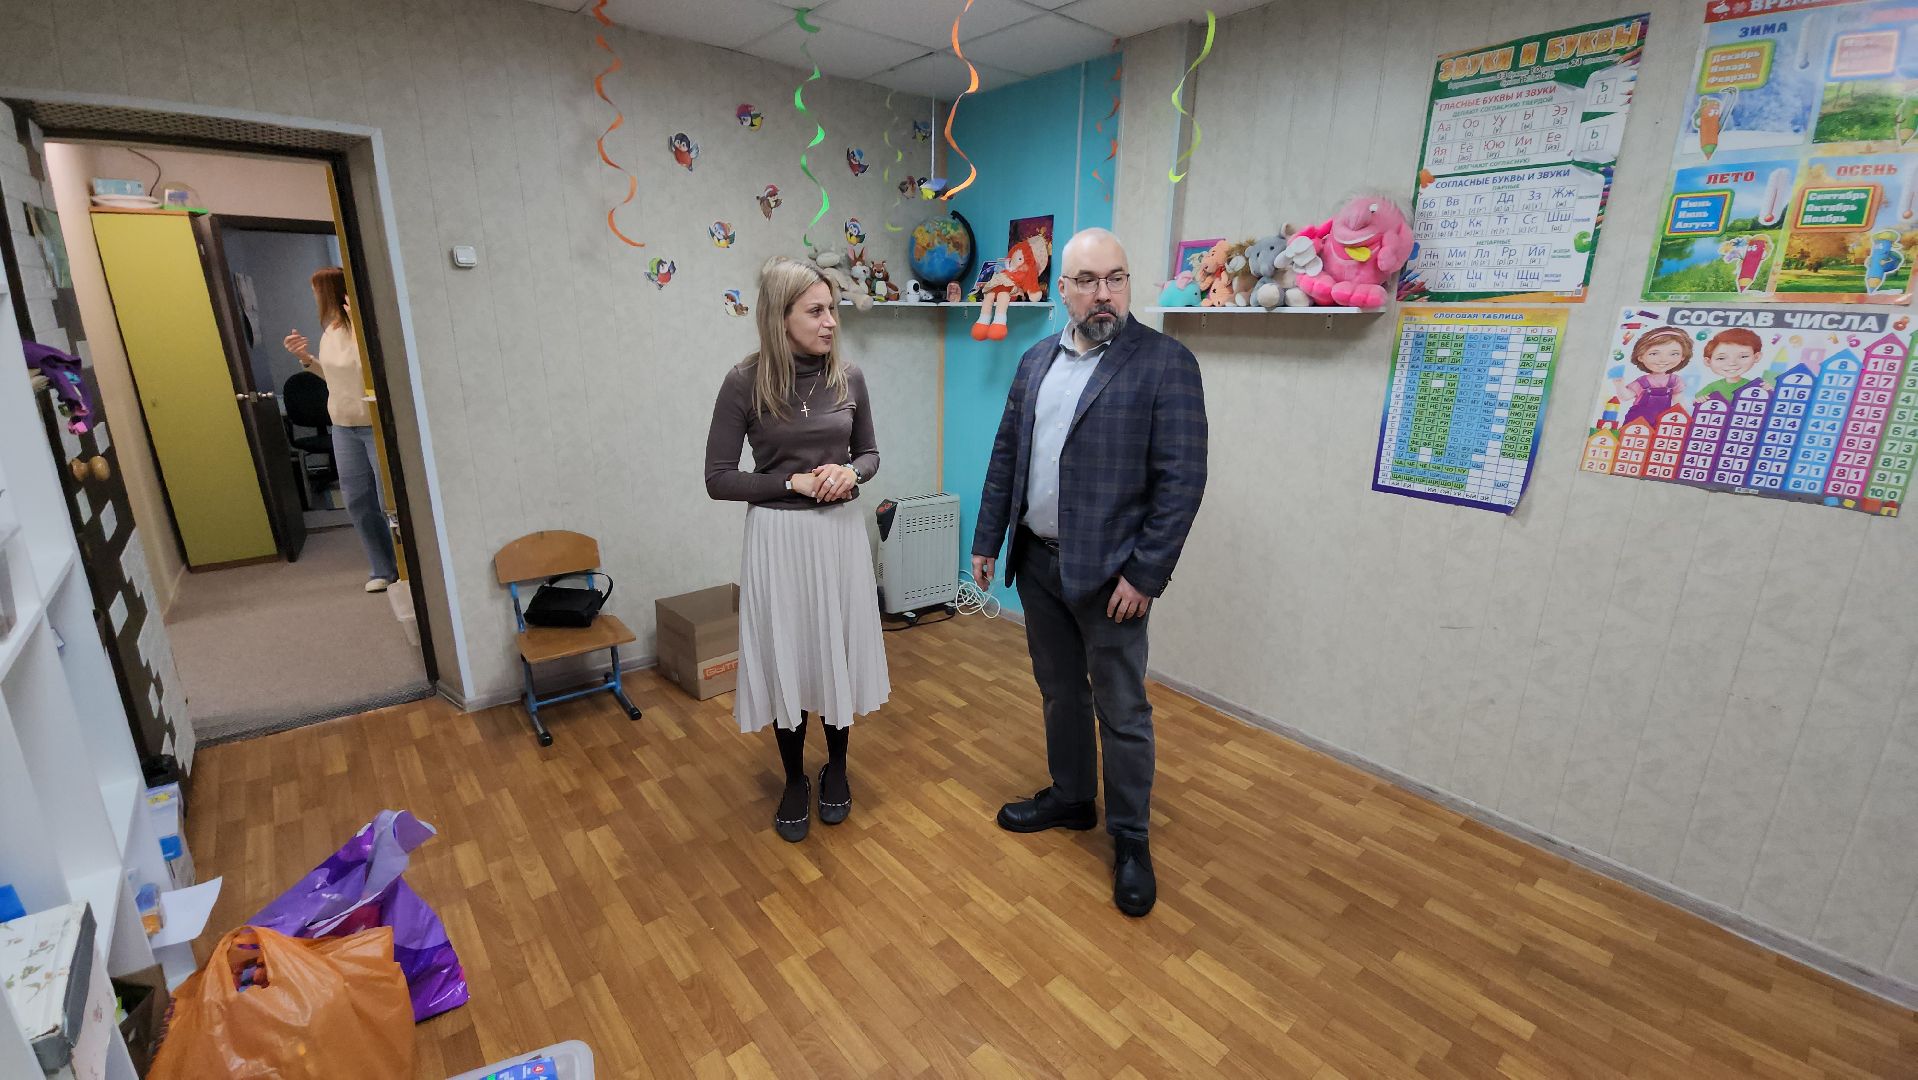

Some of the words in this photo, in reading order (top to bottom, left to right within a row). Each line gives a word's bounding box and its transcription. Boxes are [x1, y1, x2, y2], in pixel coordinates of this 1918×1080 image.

[1738, 22, 1788, 38] ЗИМА
[1438, 47, 1514, 82] ЗВУКИ
[1519, 42, 1539, 67] И
[1544, 24, 1641, 61] БУКВЫ
[1439, 99, 1481, 111] ГЛАСНЫЕ
[1482, 94, 1513, 105] БУКВЫ
[1525, 86, 1557, 98] ЗВУКИ
[1437, 123, 1451, 132] Аа
[1462, 119, 1479, 129] Оо
[1492, 114, 1507, 126] Уу
[1523, 109, 1534, 120] Ы
[1552, 105, 1568, 116] Ээ
[1483, 139, 1505, 150] Юю
[1836, 164, 1898, 177] ОСЕНЬ
[1435, 179, 1490, 189] СОГЛАСНЫЕ
[1492, 175, 1524, 185] БУКВЫ
[1537, 169, 1571, 179] ЗВУКИ
[1706, 171, 1755, 185] ЛЕТО
[1497, 193, 1514, 204] Дд
[1527, 191, 1541, 201] Зз
[1552, 187, 1576, 198] Жж
[1547, 211, 1571, 222] Шш
[1447, 249, 1466, 258] Мм
[1501, 247, 1517, 259] Рр
[1673, 310, 1774, 327] СОСТАВ
[1784, 312, 1880, 331] ЧИСЛА
[1883, 345, 1894, 354] 9
[1838, 361, 1847, 370] 8
[1872, 361, 1879, 370] 1
[1886, 362, 1896, 371] 8
[1795, 374, 1804, 383] 7
[1865, 377, 1876, 386] 2
[1883, 377, 1892, 387] 7
[1751, 389, 1760, 397] 6
[1783, 389, 1789, 398] 1
[1797, 390, 1806, 399] 6
[1861, 392, 1871, 401] 3
[1876, 394, 1887, 403] 6
[1710, 401, 1719, 411] 5
[1776, 404, 1786, 412] 2
[1792, 405, 1802, 414] 5
[1670, 414, 1678, 423] 4
[1855, 408, 1865, 417] 4
[1871, 410, 1882, 419] 5
[1772, 419, 1782, 427] 3
[1787, 421, 1797, 429] 4
[1850, 423, 1861, 432] 5
[1866, 426, 1876, 434] 4
[1633, 426, 1642, 435] 3
[1662, 426, 1667, 434] 1
[1673, 428, 1682, 436] 3
[1694, 429, 1704, 437] 2
[1708, 430, 1717, 439] 3
[1599, 437, 1607, 446] 2
[1637, 440, 1644, 448] 2
[1783, 435, 1792, 444] 3
[1846, 438, 1856, 447] 6
[1861, 441, 1871, 449] 3
[1657, 440, 1665, 448] 2
[1669, 441, 1679, 450] 2
[1691, 442, 1700, 450] 3
[1704, 444, 1713, 452] 2
[1592, 449, 1597, 457] 1
[1620, 451, 1629, 459] 2
[1635, 453, 1640, 461] 1
[1653, 453, 1661, 461] 3
[1763, 447, 1773, 456] 5
[1777, 449, 1788, 458] 2
[1702, 458, 1707, 466] 1
[1842, 454, 1851, 462] 7
[1856, 456, 1867, 465] 2
[1587, 461, 1594, 470] 2
[1617, 464, 1625, 472] 3
[1630, 466, 1638, 474] 0
[1758, 462, 1768, 470] 6
[1662, 468, 1671, 476] 0
[1683, 470, 1691, 478] 5
[1696, 471, 1705, 479] 0
[1836, 469, 1847, 477] 8
[1854, 471, 1860, 480] 1
[1769, 478, 1778, 486] 0
[1831, 483, 1842, 492] 9
[1847, 486, 1857, 494] 0
